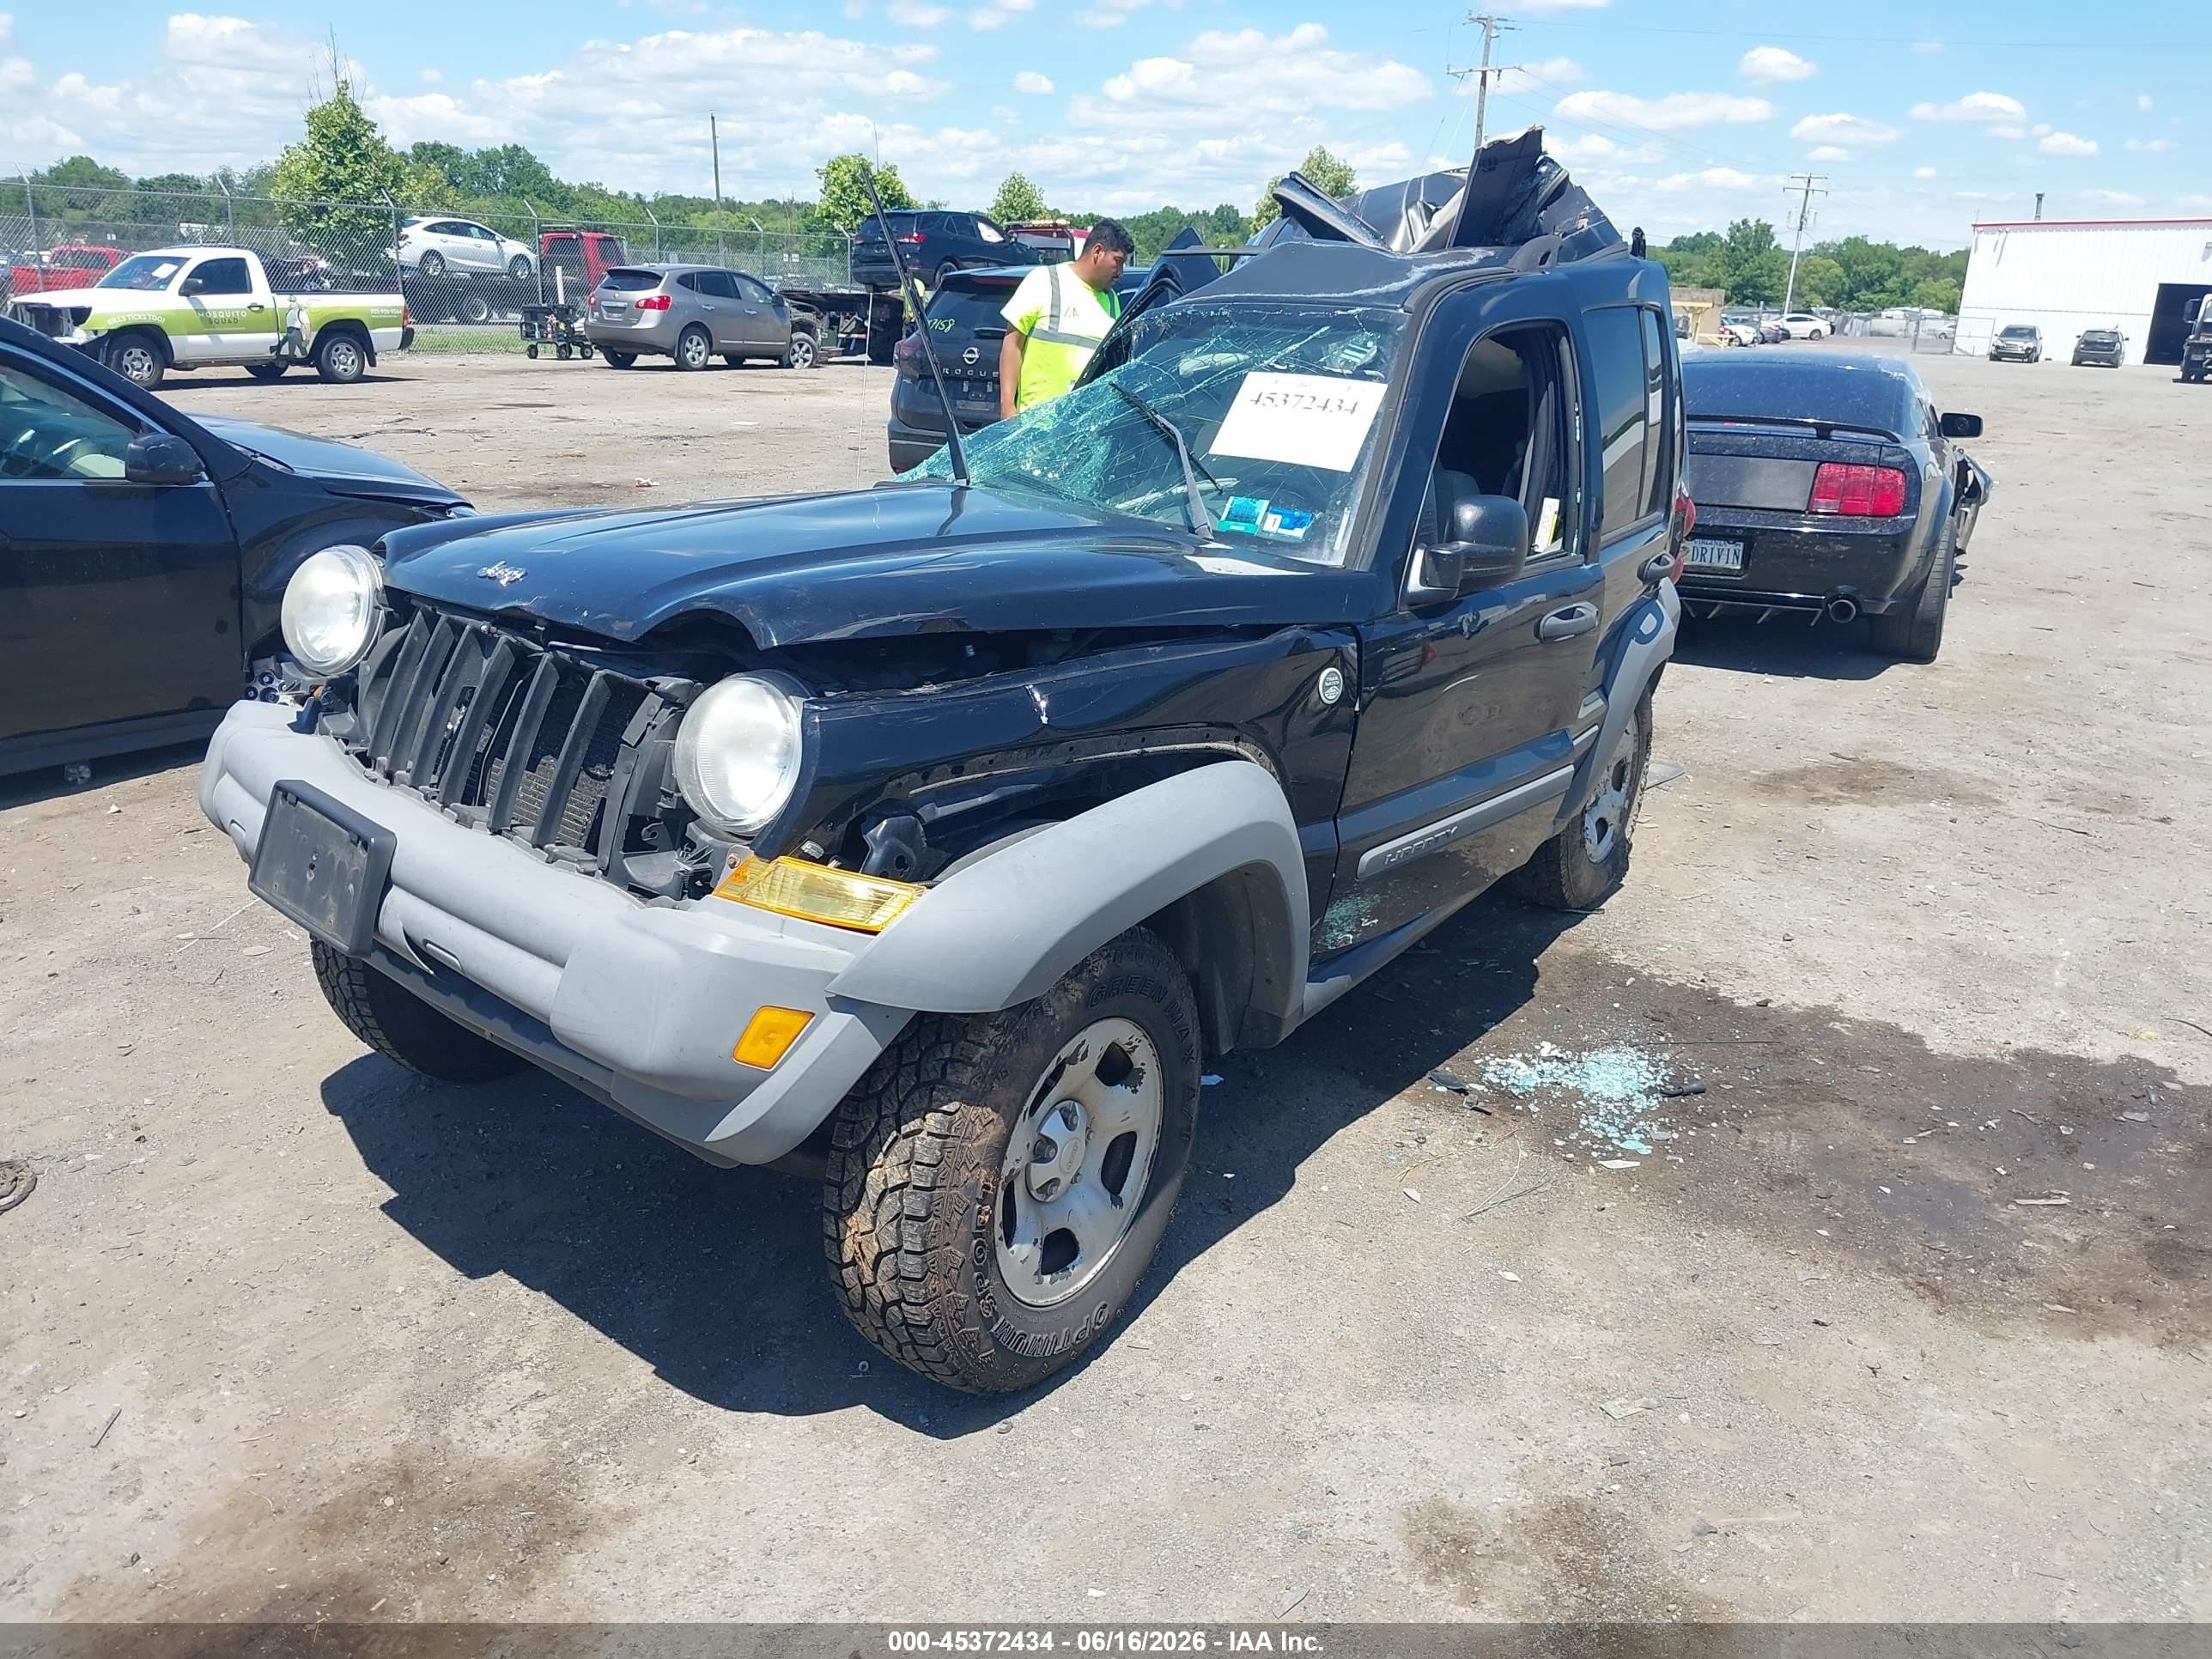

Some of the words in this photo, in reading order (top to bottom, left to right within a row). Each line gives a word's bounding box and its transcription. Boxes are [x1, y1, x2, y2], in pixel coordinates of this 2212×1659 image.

[148, 314, 166, 323] TOO!
[1250, 392, 1358, 416] 45372434
[1692, 546, 1741, 565] DRIVIN
[1088, 975, 1169, 1009] GREEN
[1165, 1001, 1196, 1066] MAX
[990, 1301, 1111, 1358] OPTIMUM
